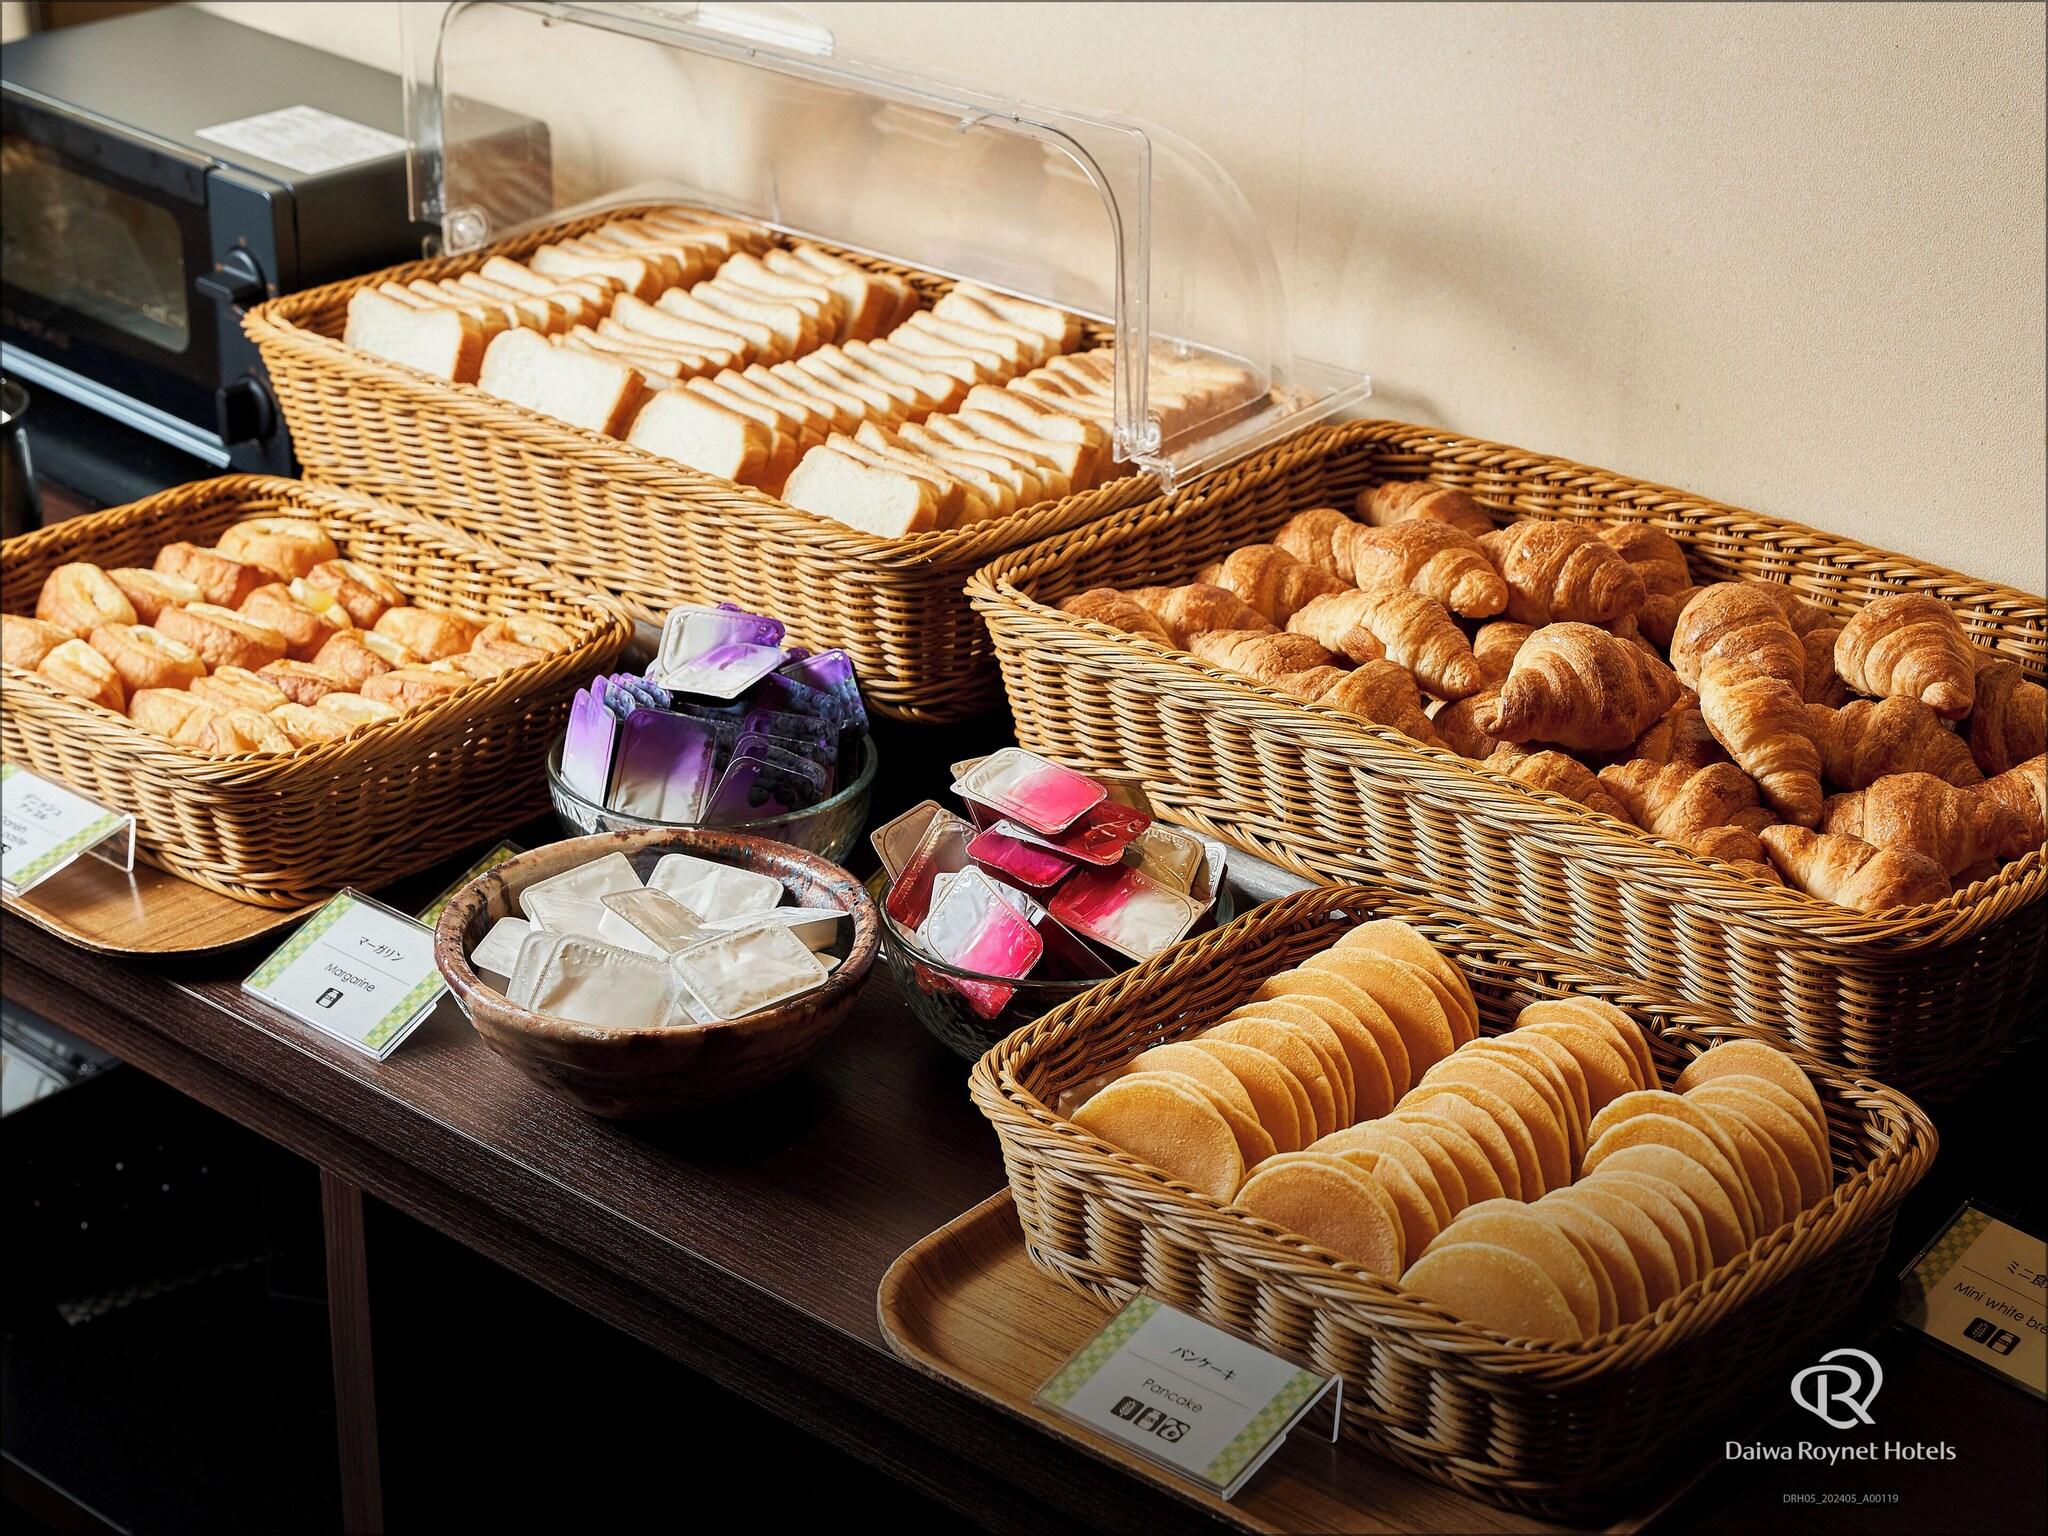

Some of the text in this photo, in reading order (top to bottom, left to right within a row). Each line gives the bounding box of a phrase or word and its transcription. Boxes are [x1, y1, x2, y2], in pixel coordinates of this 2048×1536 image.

[358, 936, 405, 962] マーガリン
[324, 963, 376, 992] Margarine
[1953, 1282, 1986, 1302] Mini
[1986, 1296, 2025, 1322] white
[1170, 1346, 1237, 1382] パンケーキ
[1141, 1377, 1203, 1414] Pancake
